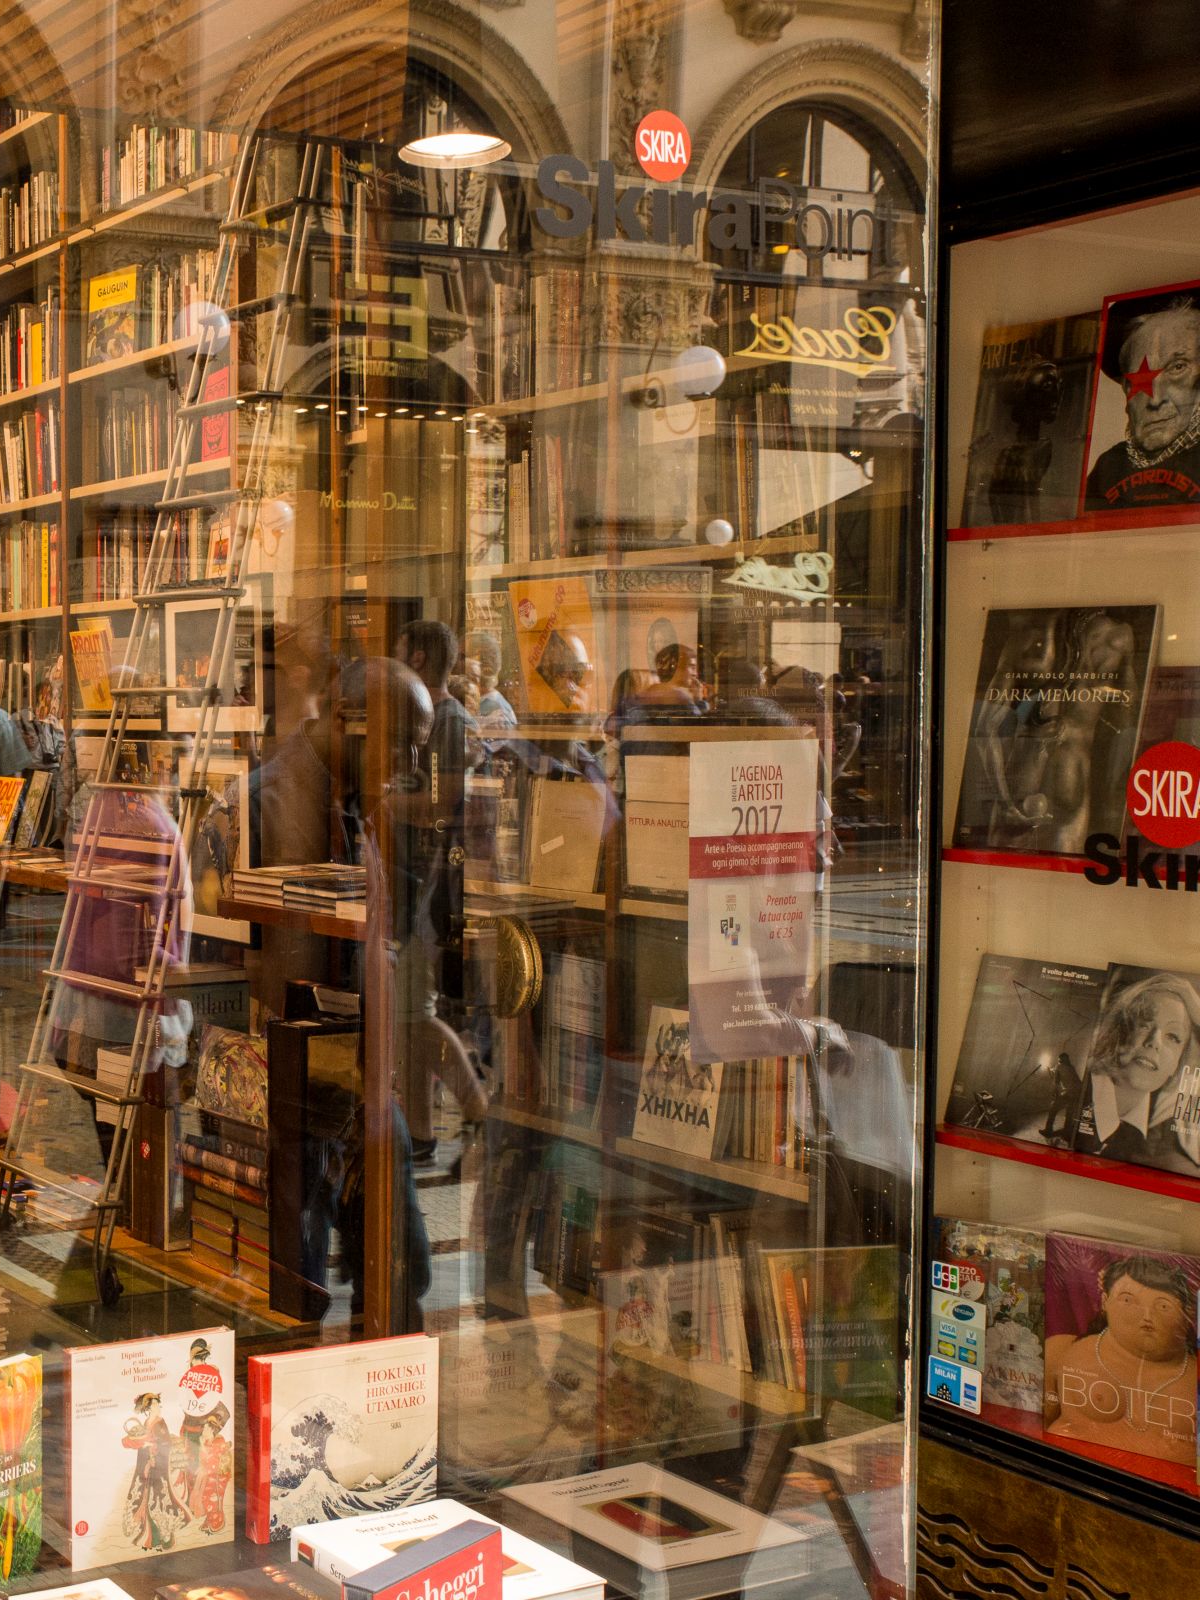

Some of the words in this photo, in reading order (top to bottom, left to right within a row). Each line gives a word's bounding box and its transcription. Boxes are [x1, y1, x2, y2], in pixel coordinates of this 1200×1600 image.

[639, 128, 687, 165] SKIRA
[97, 279, 129, 298] GAUGUIN
[72, 633, 100, 655] PROUT
[1005, 672, 1029, 680] GIAN
[1032, 672, 1065, 680] PAOLO
[1069, 672, 1120, 680] BARBIERI
[988, 687, 1035, 702] DARK
[1037, 687, 1131, 704] MEMORIES
[731, 765, 783, 782] L'AGENDA
[738, 783, 783, 801] ARTISTI
[629, 816, 655, 826] PITTURA
[731, 804, 783, 836] 2017
[704, 844, 720, 854] Arte
[726, 843, 747, 853] Poesia
[747, 841, 804, 853] accompagneranno
[712, 858, 728, 870] ogni
[728, 858, 749, 870] giorno
[750, 856, 760, 866] del
[761, 856, 780, 865] nuovo
[781, 855, 797, 864] anno
[766, 894, 797, 906] Prenota
[758, 911, 767, 923] la
[768, 911, 781, 922] tua
[782, 910, 804, 923] copia
[769, 931, 775, 940] a
[1047, 968, 1062, 976] volto
[1063, 970, 1090, 980] dell'arte
[193, 990, 243, 1014] illard
[934, 1271, 958, 1284] JCB
[941, 1321, 957, 1333] VISA
[121, 1351, 145, 1361] Dipinti
[121, 1368, 132, 1377] del
[133, 1366, 156, 1375] Mondo
[133, 1372, 168, 1384] Fluttuante
[187, 1371, 219, 1385] PREZZO
[366, 1363, 427, 1384] HOKUSAI
[934, 1367, 957, 1381] MILAN
[181, 1379, 221, 1393] SPECIALE
[366, 1379, 427, 1399] HIROSHIGE
[366, 1394, 427, 1415] UTAMARO
[1062, 1373, 1196, 1434] BOTER
[355, 1523, 386, 1535] Serge
[389, 1513, 439, 1532] Poliakoff
